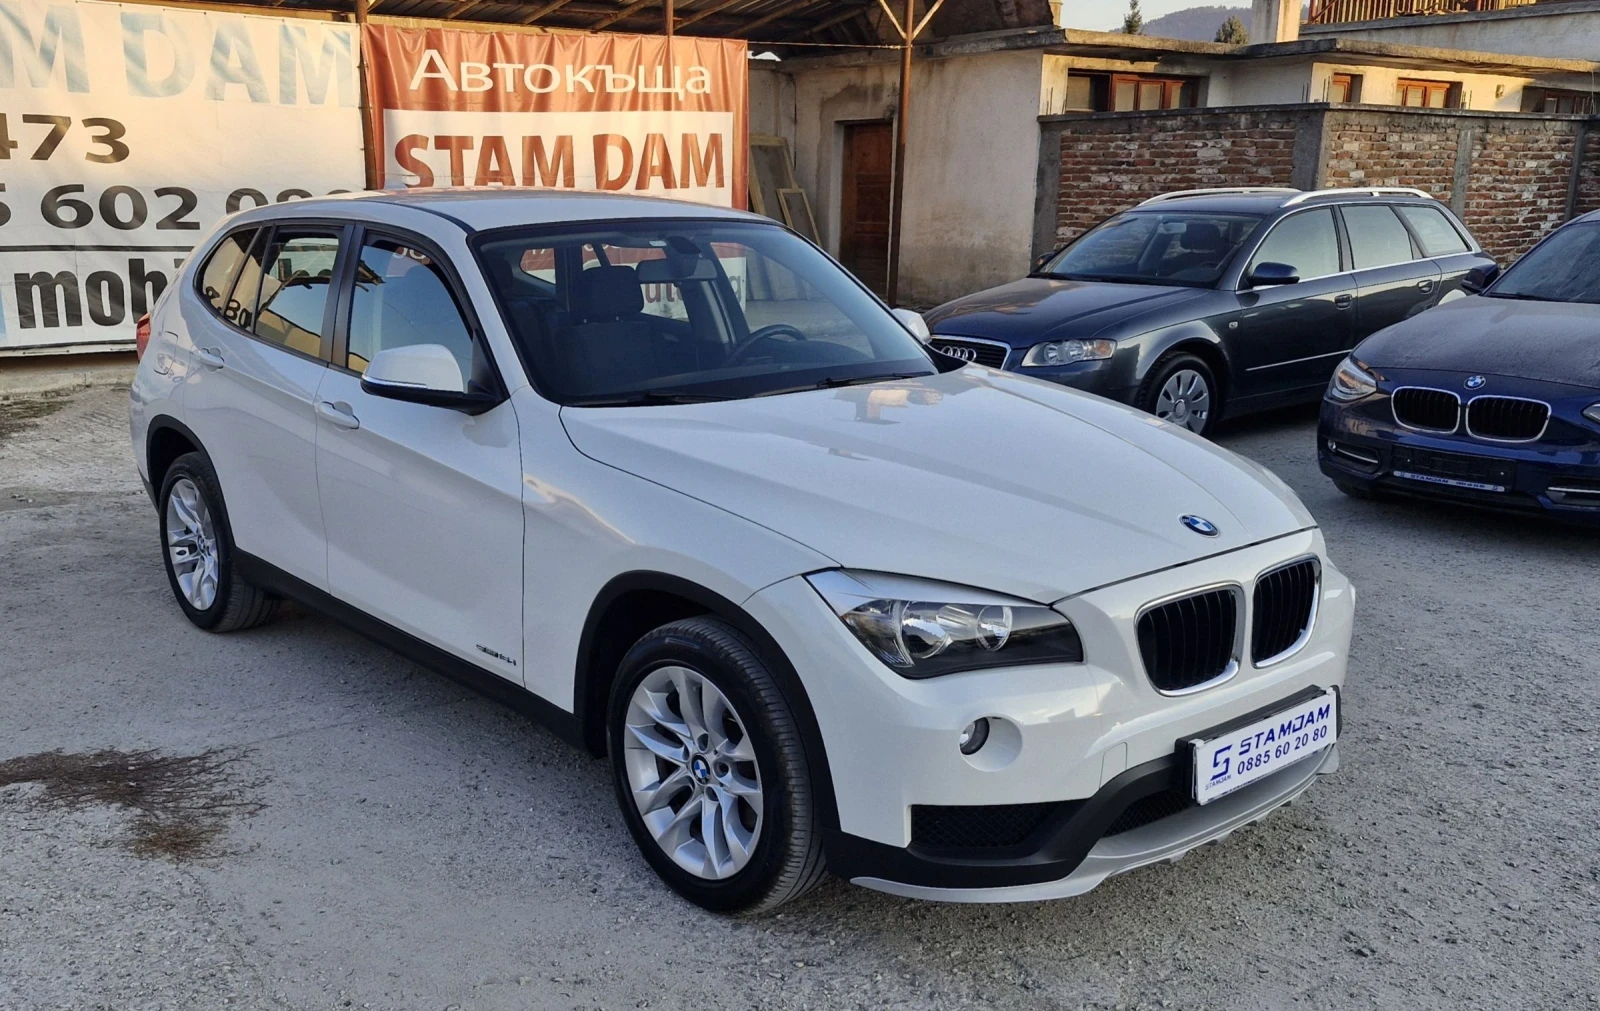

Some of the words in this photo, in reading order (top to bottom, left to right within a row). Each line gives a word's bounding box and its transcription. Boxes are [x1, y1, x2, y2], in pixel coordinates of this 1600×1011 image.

[119, 11, 356, 108] DAM
[409, 49, 712, 101] Автокъща
[394, 133, 575, 188] STAM
[592, 132, 725, 190] DAM
[40, 183, 201, 230] 602
[1237, 749, 1271, 775] 0885
[1274, 741, 1290, 759] 60
[1294, 732, 1309, 750] 20
[1312, 724, 1328, 742] 80
